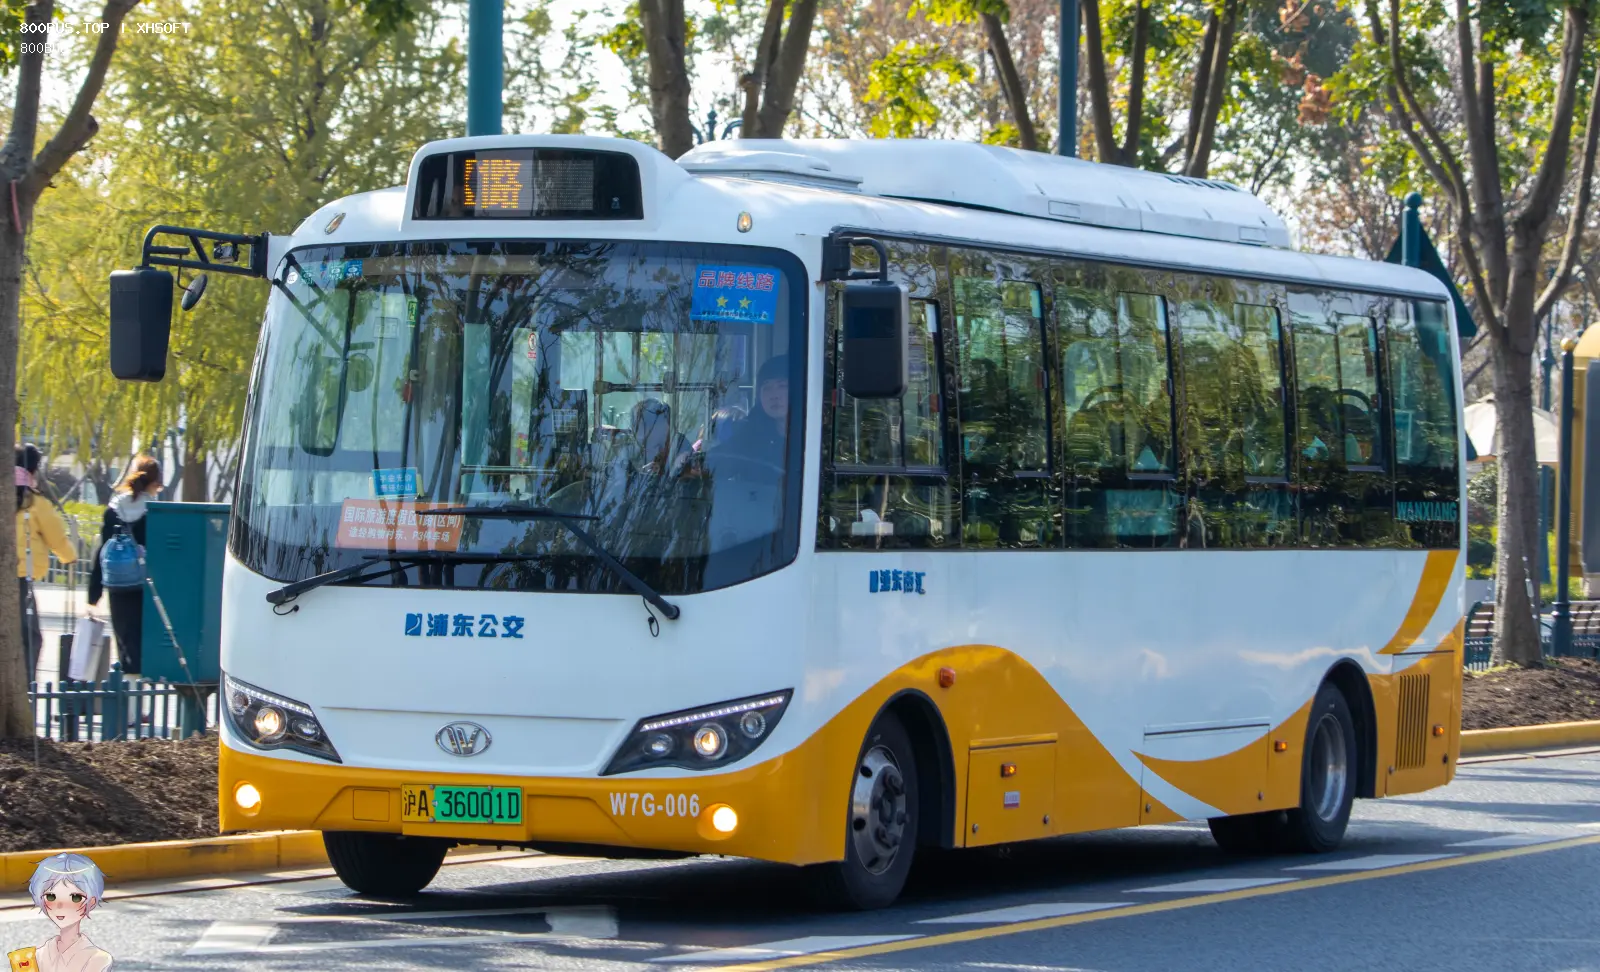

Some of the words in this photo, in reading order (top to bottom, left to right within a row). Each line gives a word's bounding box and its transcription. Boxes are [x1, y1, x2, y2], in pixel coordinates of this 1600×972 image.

[697, 270, 774, 292] 品牌线路
[1396, 501, 1457, 522] WANXIANG
[425, 612, 525, 639] 浦东公交
[440, 789, 521, 820] 36001D
[609, 791, 700, 818] W7G-006
